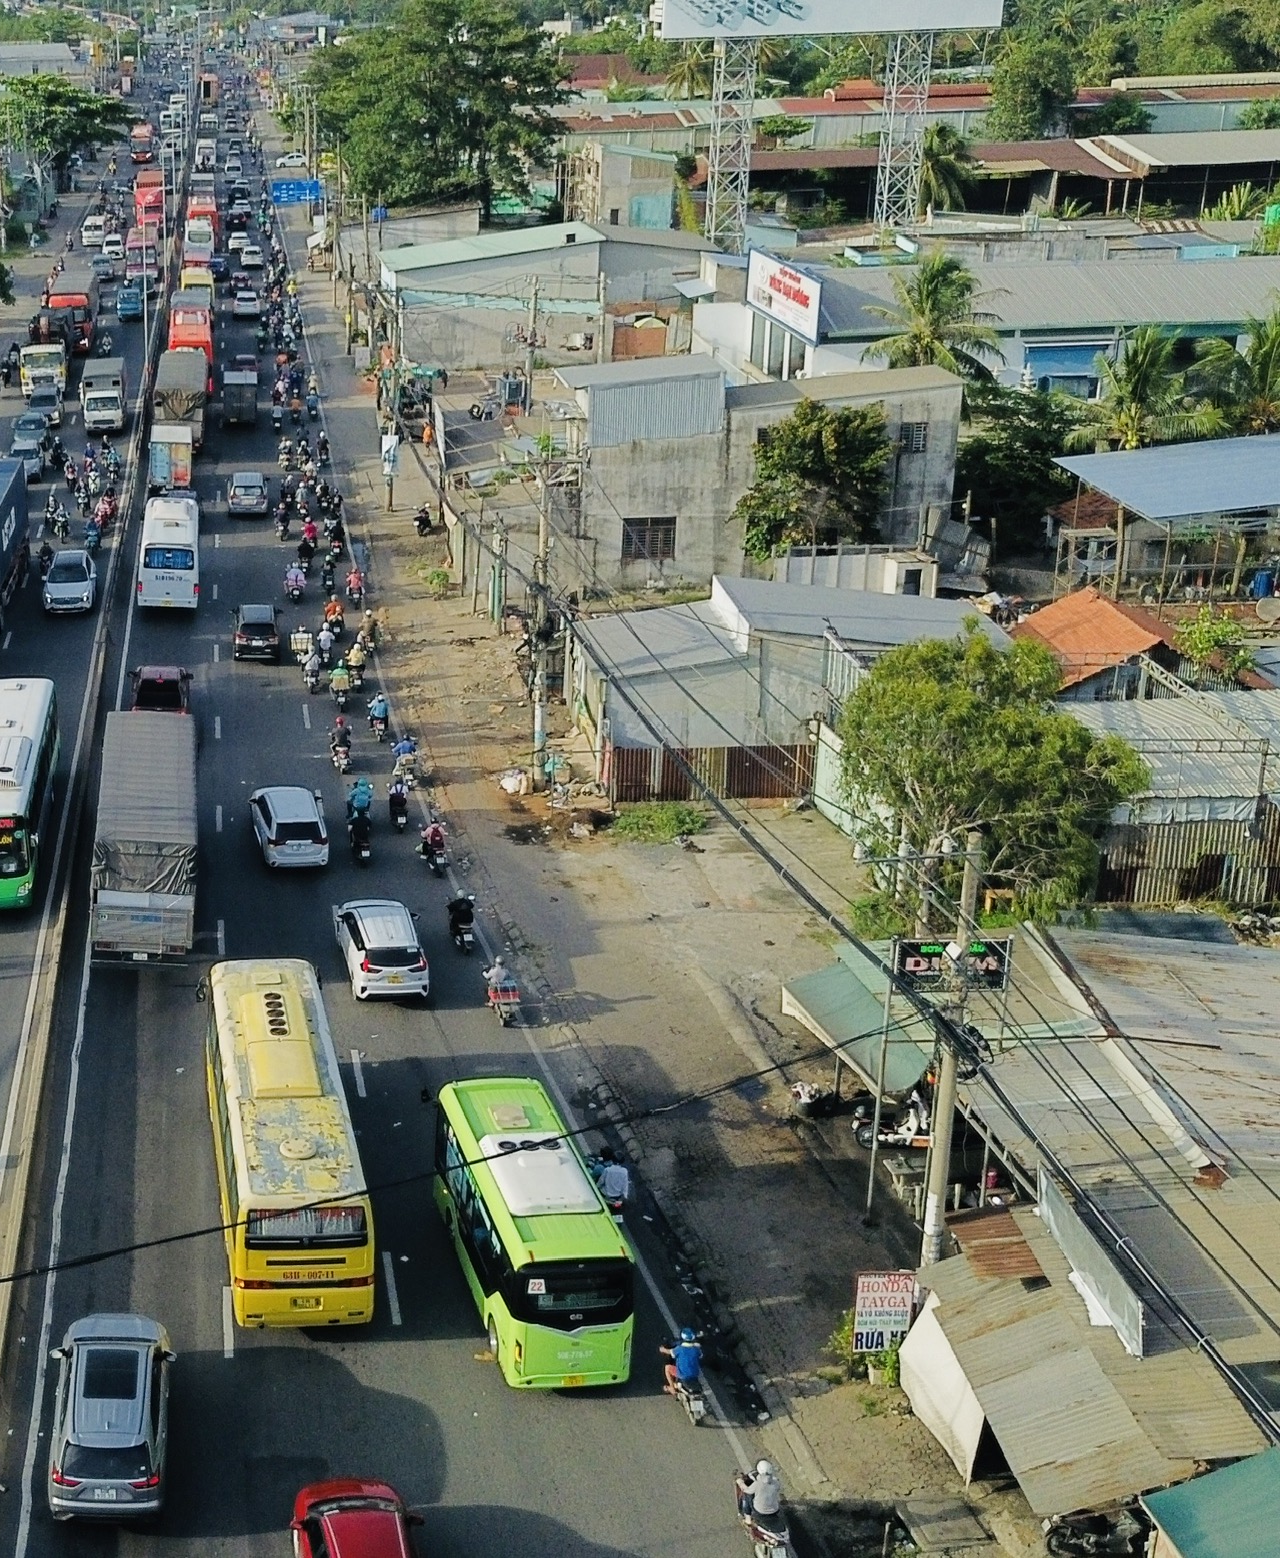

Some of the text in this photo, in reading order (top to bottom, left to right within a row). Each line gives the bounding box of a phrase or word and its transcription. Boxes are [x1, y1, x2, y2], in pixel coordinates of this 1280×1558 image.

[283, 1271, 300, 1280] 63B
[530, 1281, 543, 1291] 22
[860, 1281, 910, 1293] HONDA
[860, 1296, 907, 1308] TAYGA
[854, 1328, 885, 1350] RỬA
